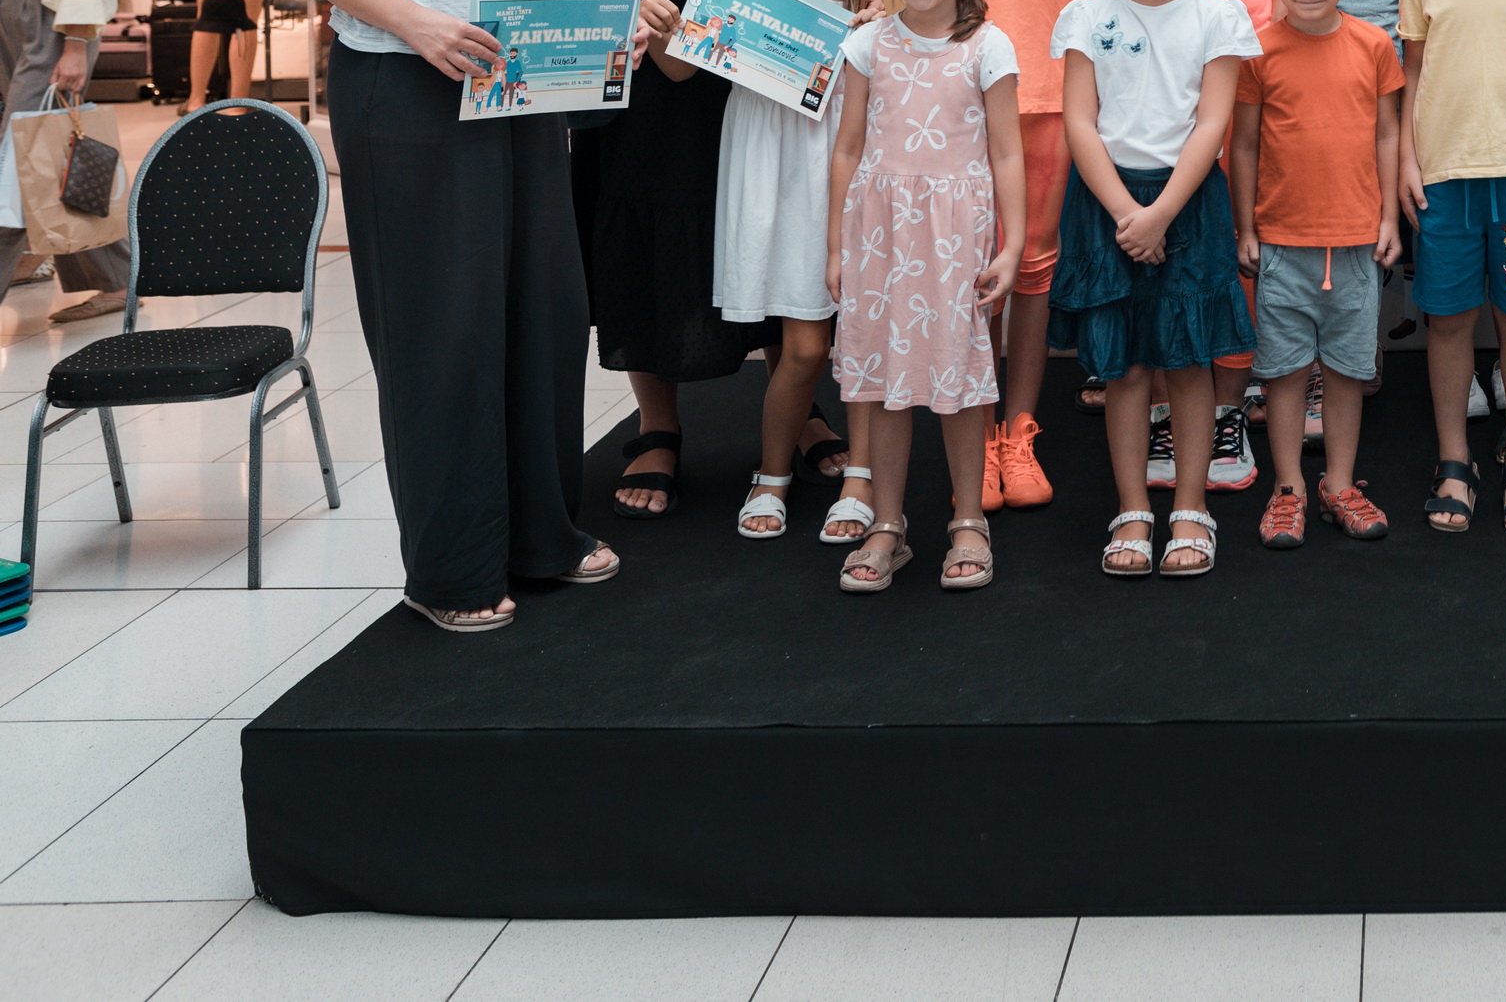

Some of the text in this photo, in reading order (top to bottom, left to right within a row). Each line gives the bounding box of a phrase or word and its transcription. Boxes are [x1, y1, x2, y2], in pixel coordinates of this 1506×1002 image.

[599, 2, 629, 10] memento
[816, 16, 844, 33] memento
[508, 26, 613, 44] ZAHVALNICU
[605, 85, 621, 93] BIG
[804, 91, 820, 104] BIG
